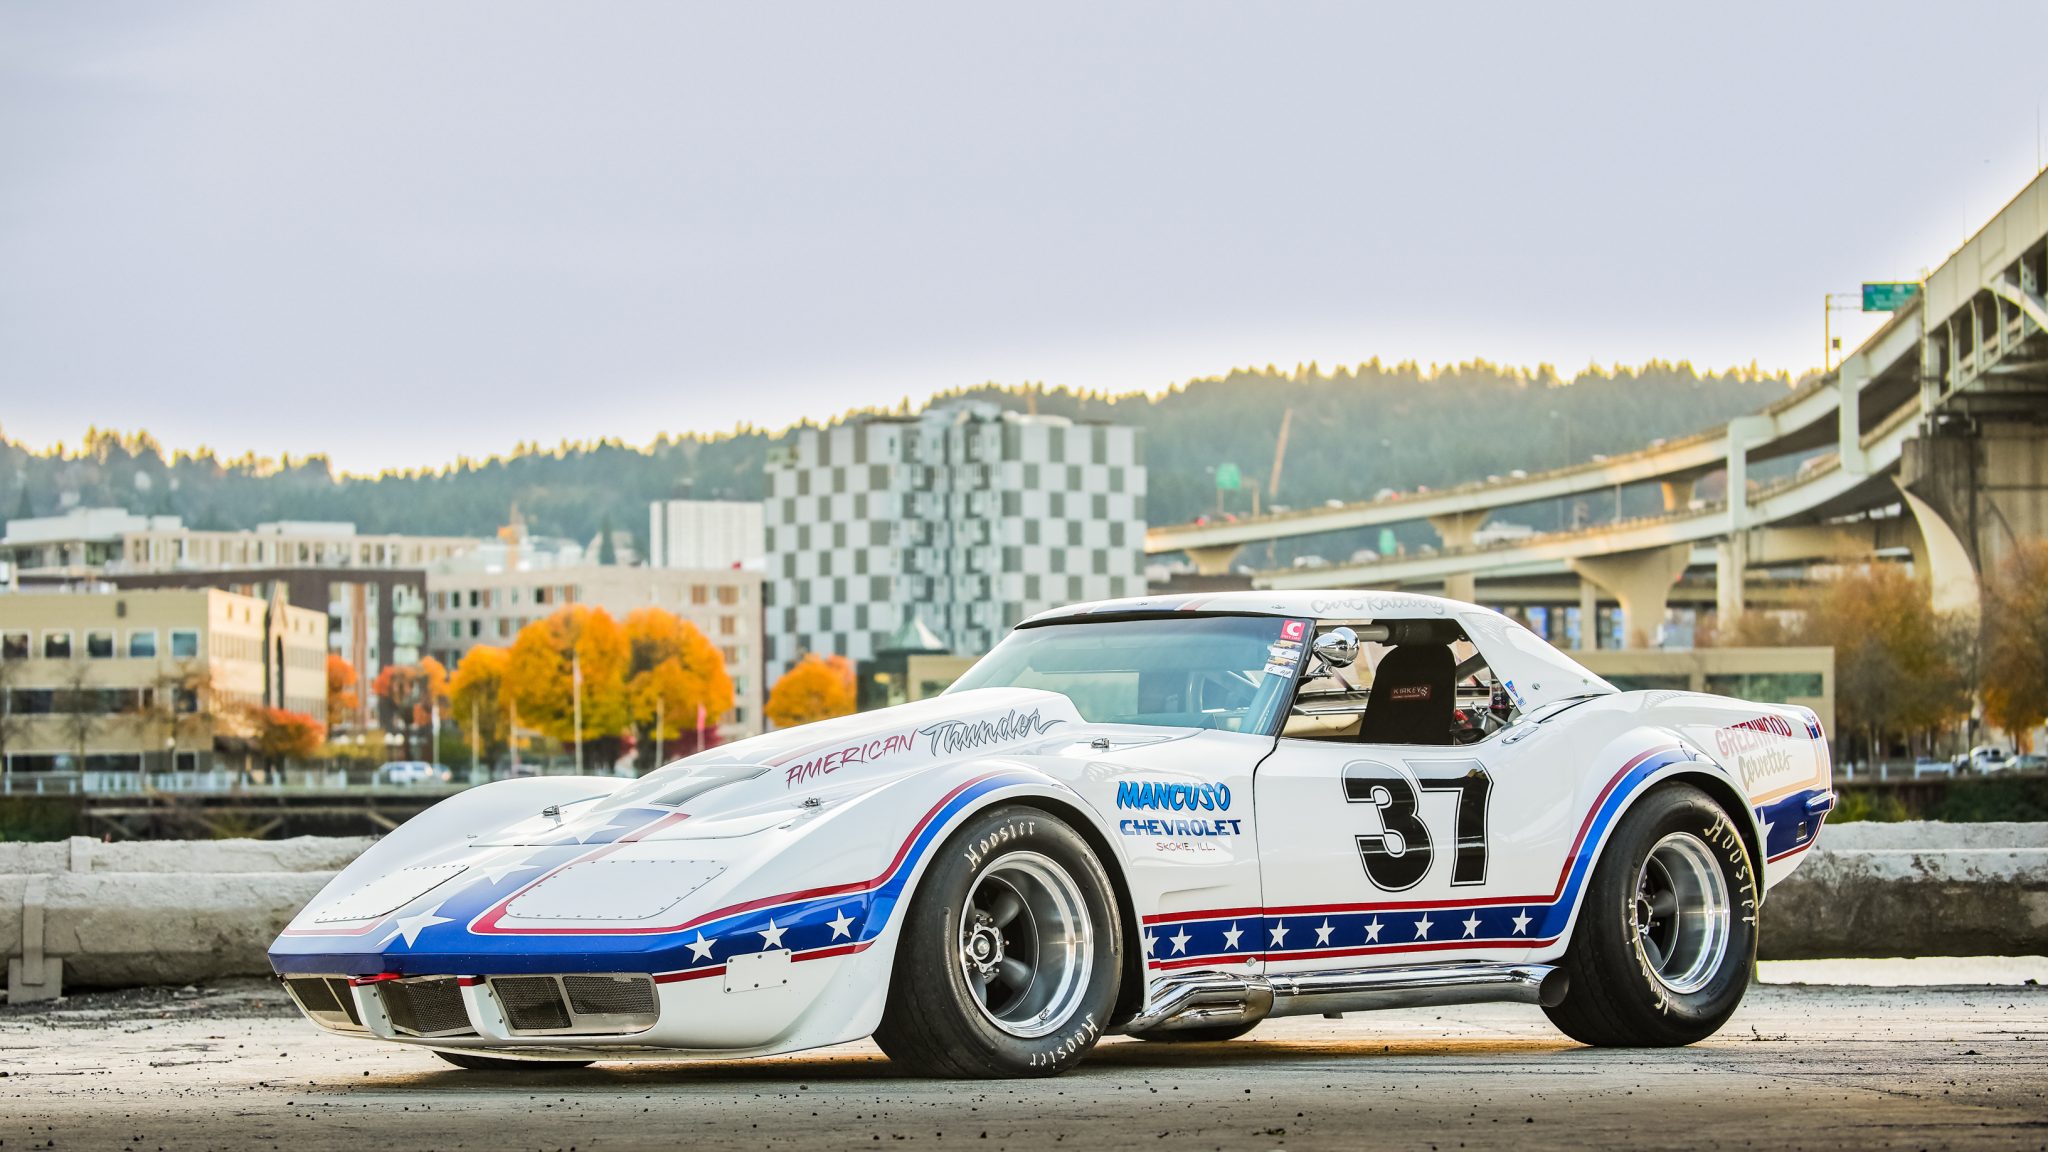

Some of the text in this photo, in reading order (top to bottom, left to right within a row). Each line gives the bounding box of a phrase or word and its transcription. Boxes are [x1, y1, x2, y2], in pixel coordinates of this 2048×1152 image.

[785, 708, 1067, 790] AMERICAN Thunder
[1714, 714, 1793, 758] GREENWOOD
[1117, 781, 1231, 811] MANCUSO
[964, 818, 1035, 872] Hoosier
[1120, 819, 1241, 836] CHEVROLET
[1156, 842, 1216, 852] SKOKIE, ILL.
[1341, 758, 1494, 892] 37
[1704, 811, 1756, 926] Hoosier
[1029, 1013, 1099, 1069] Hoosier
